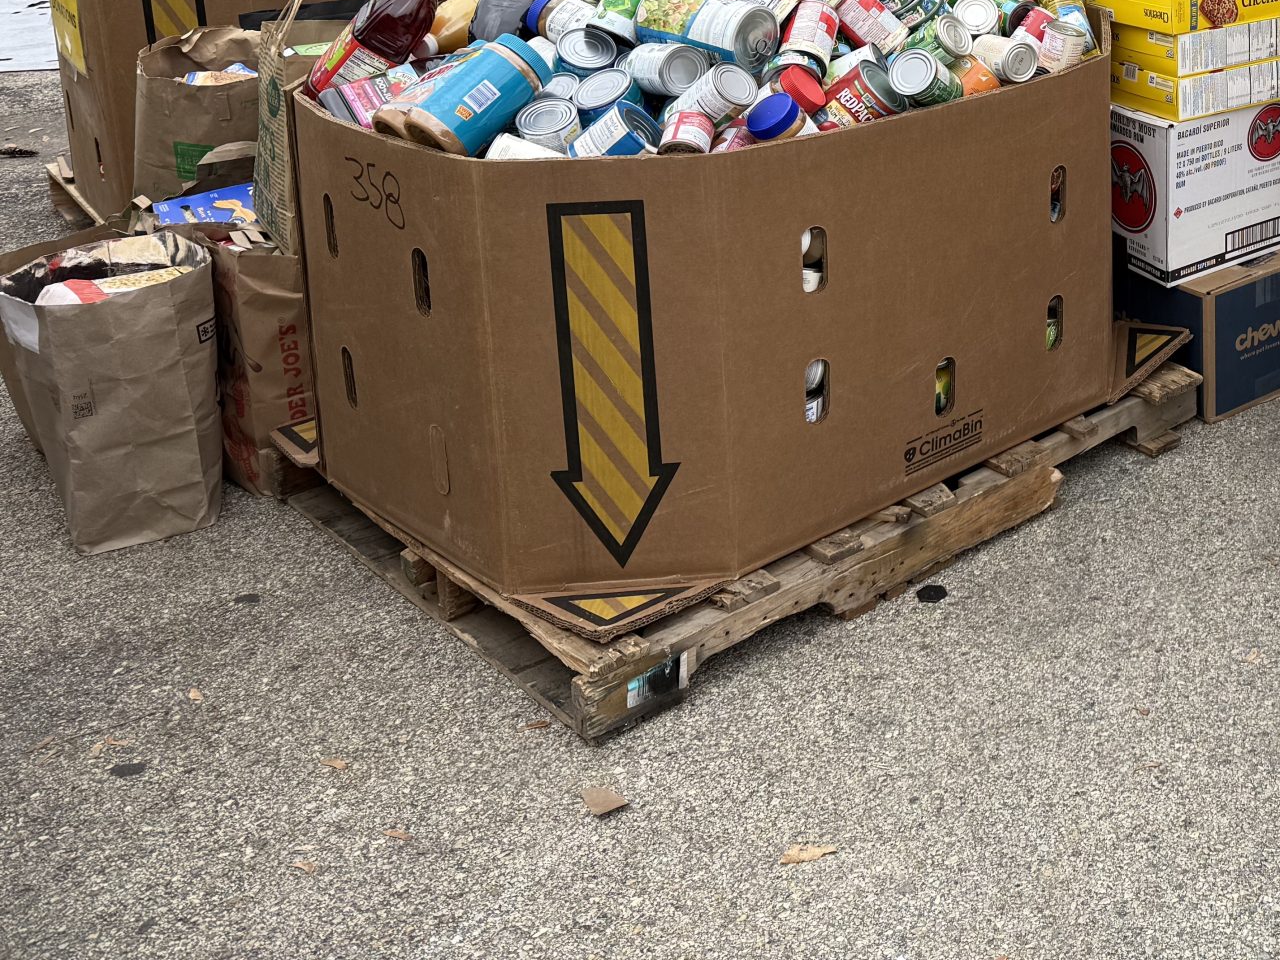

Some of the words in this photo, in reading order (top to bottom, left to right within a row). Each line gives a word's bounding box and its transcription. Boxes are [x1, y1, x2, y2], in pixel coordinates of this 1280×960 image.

[1144, 8, 1169, 23] Cheerios
[1138, 123, 1156, 138] MOST
[1202, 118, 1230, 133] SUPERIOR
[1133, 132, 1144, 143] RUM
[1176, 150, 1190, 159] MADE
[1196, 143, 1213, 154] PUERTO
[1213, 140, 1224, 149] RICO
[1201, 150, 1220, 162] BOTTLES
[1227, 144, 1242, 154] LITERS
[1176, 180, 1186, 189] RUM
[344, 156, 405, 229] 358
[1184, 202, 1201, 213] PRODUCED
[280, 323, 301, 377] JOE'S
[1240, 349, 1256, 360] where
[919, 418, 983, 456] ClimaBin
